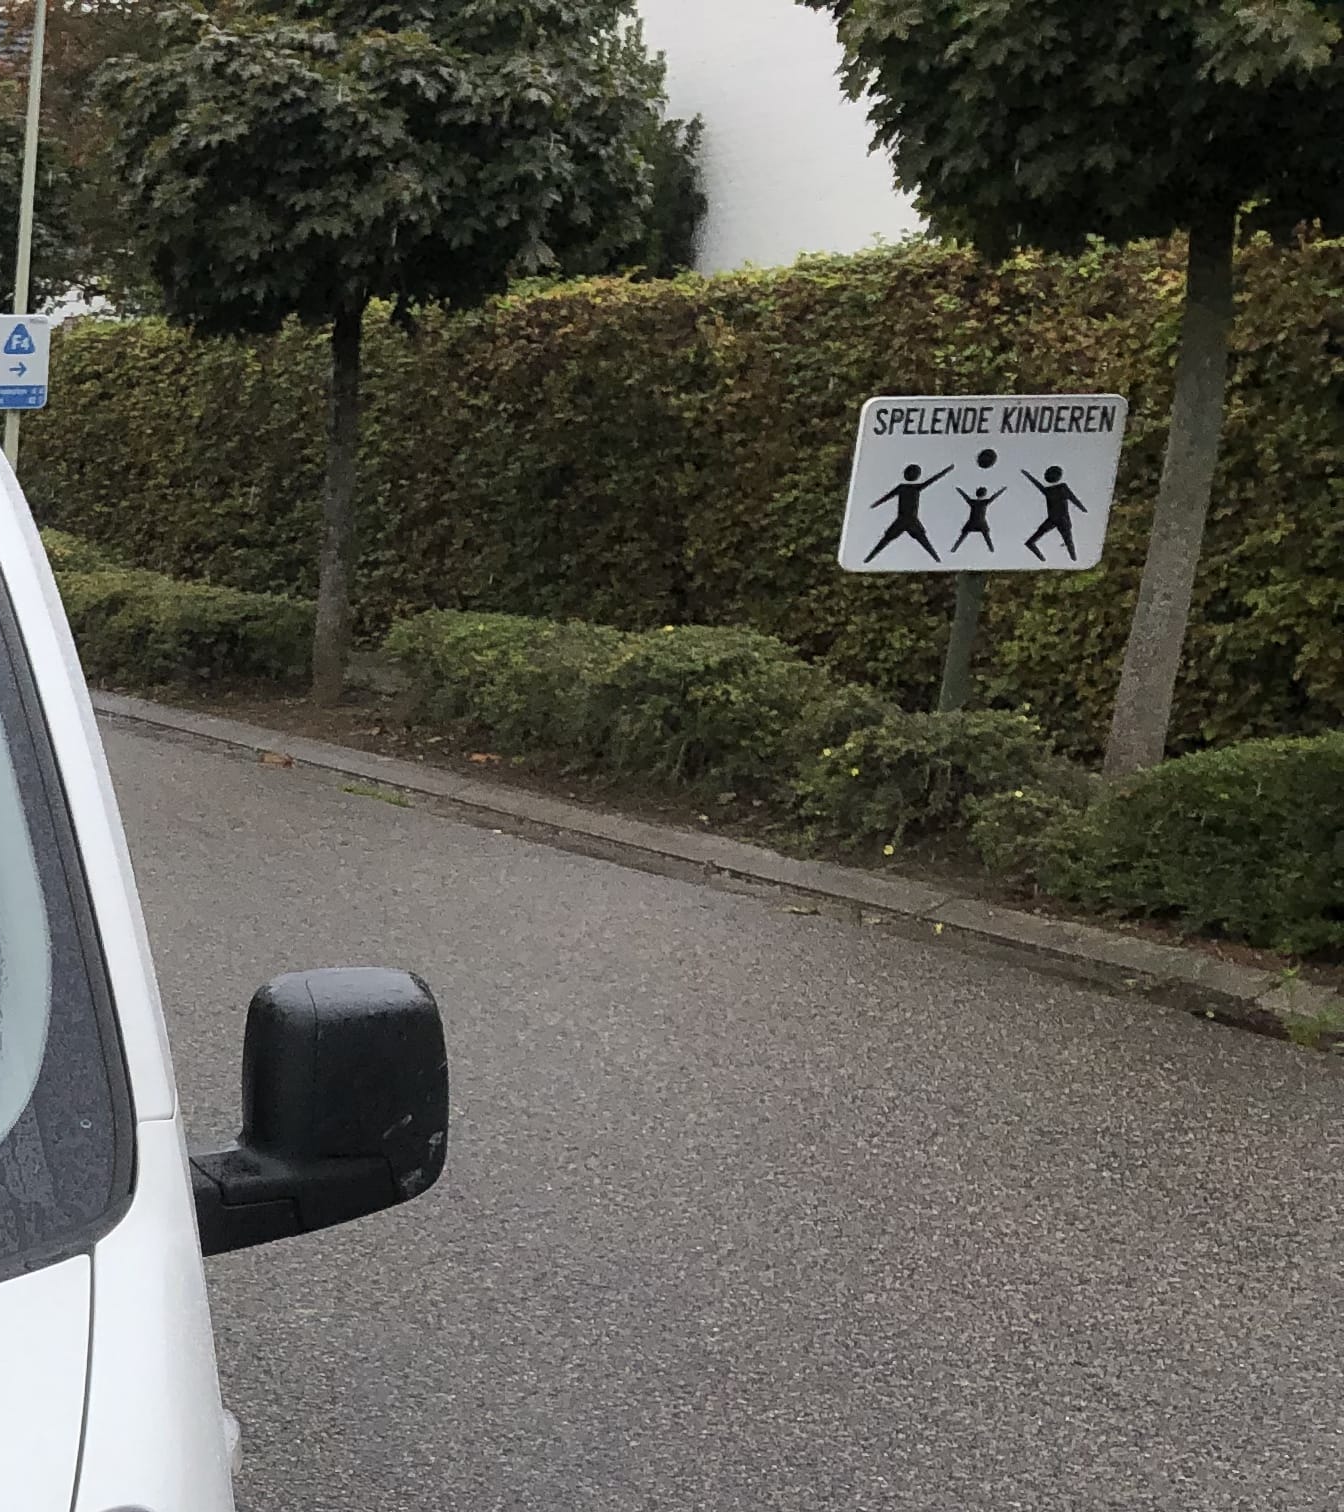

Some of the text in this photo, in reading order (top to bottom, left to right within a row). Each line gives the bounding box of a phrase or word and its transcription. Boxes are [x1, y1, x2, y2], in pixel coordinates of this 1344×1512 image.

[11, 334, 30, 351] F4
[873, 405, 1117, 435] SPELENDE KINDEREN
